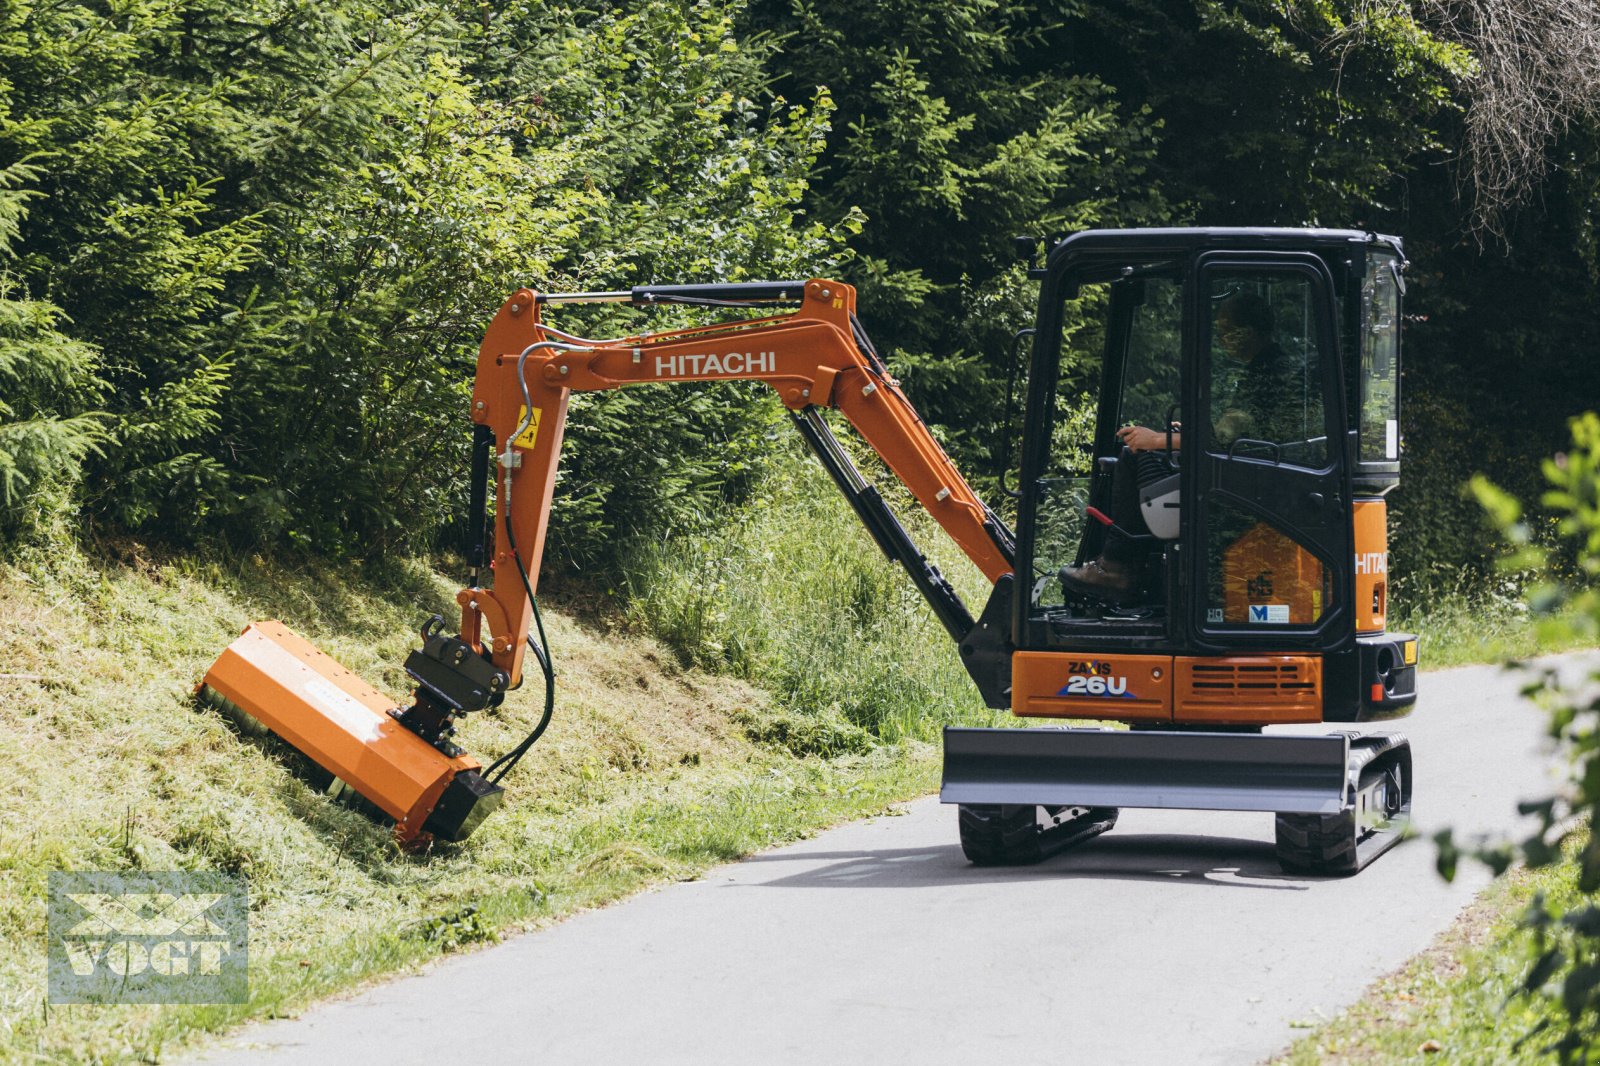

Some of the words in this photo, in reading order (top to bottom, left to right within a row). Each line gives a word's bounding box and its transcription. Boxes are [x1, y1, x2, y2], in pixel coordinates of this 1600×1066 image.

[655, 351, 776, 376] HITACHI
[1068, 659, 1111, 675] ZAXIS
[1067, 675, 1127, 695] 26U
